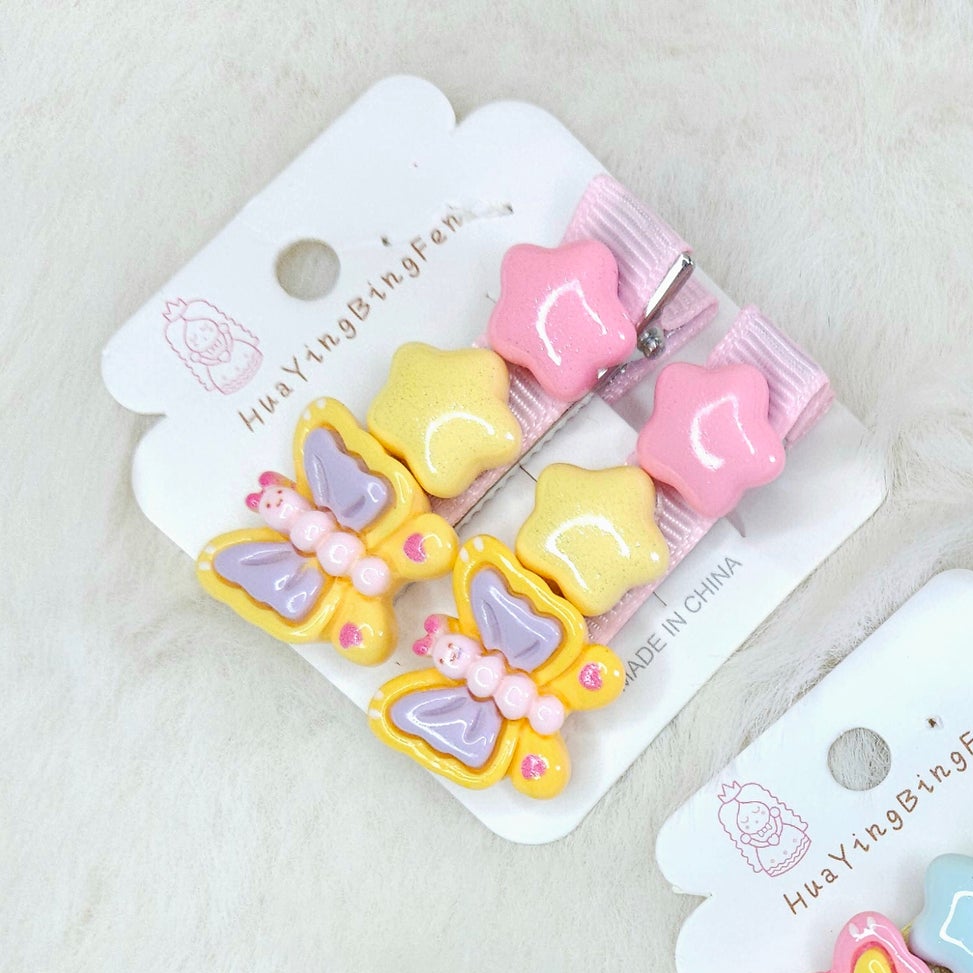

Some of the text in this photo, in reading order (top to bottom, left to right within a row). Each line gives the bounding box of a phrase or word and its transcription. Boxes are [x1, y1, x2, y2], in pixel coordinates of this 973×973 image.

[237, 212, 464, 432] HuaYingBingFen
[661, 610, 688, 637] IN
[684, 557, 743, 614] CHINA
